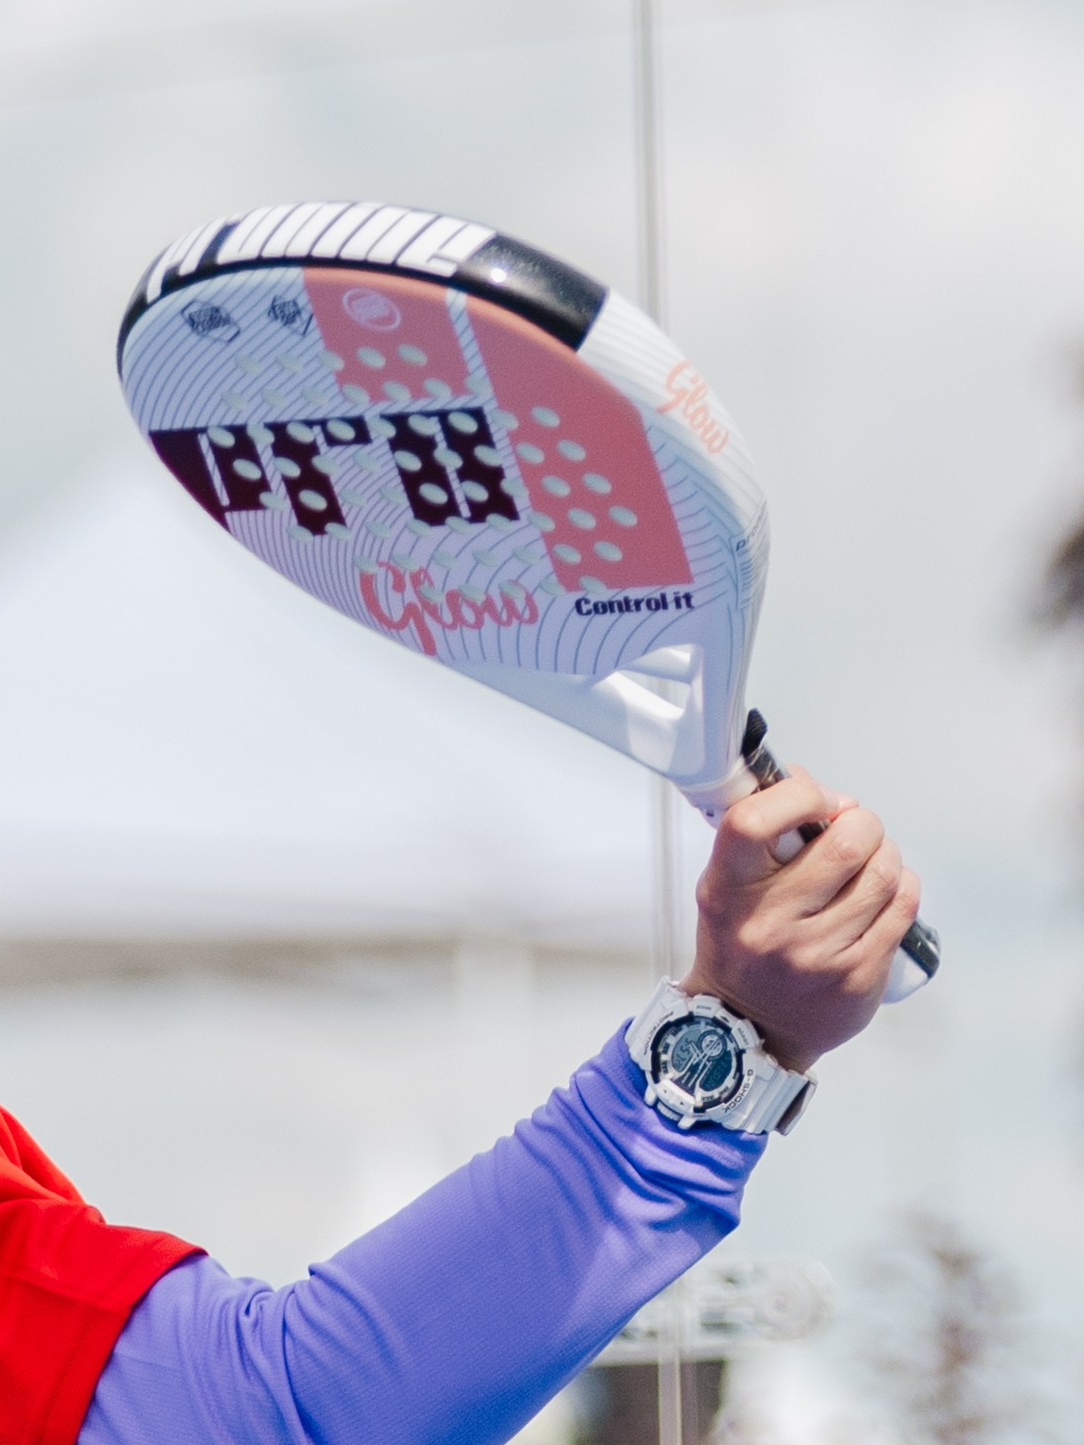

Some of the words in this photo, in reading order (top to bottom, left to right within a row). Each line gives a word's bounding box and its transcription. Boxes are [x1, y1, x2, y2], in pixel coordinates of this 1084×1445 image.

[654, 358, 730, 455] Glow
[359, 560, 539, 657] Glow
[575, 592, 668, 617] Control
[673, 591, 696, 611] it
[723, 1068, 754, 1113] G-SHOCK
